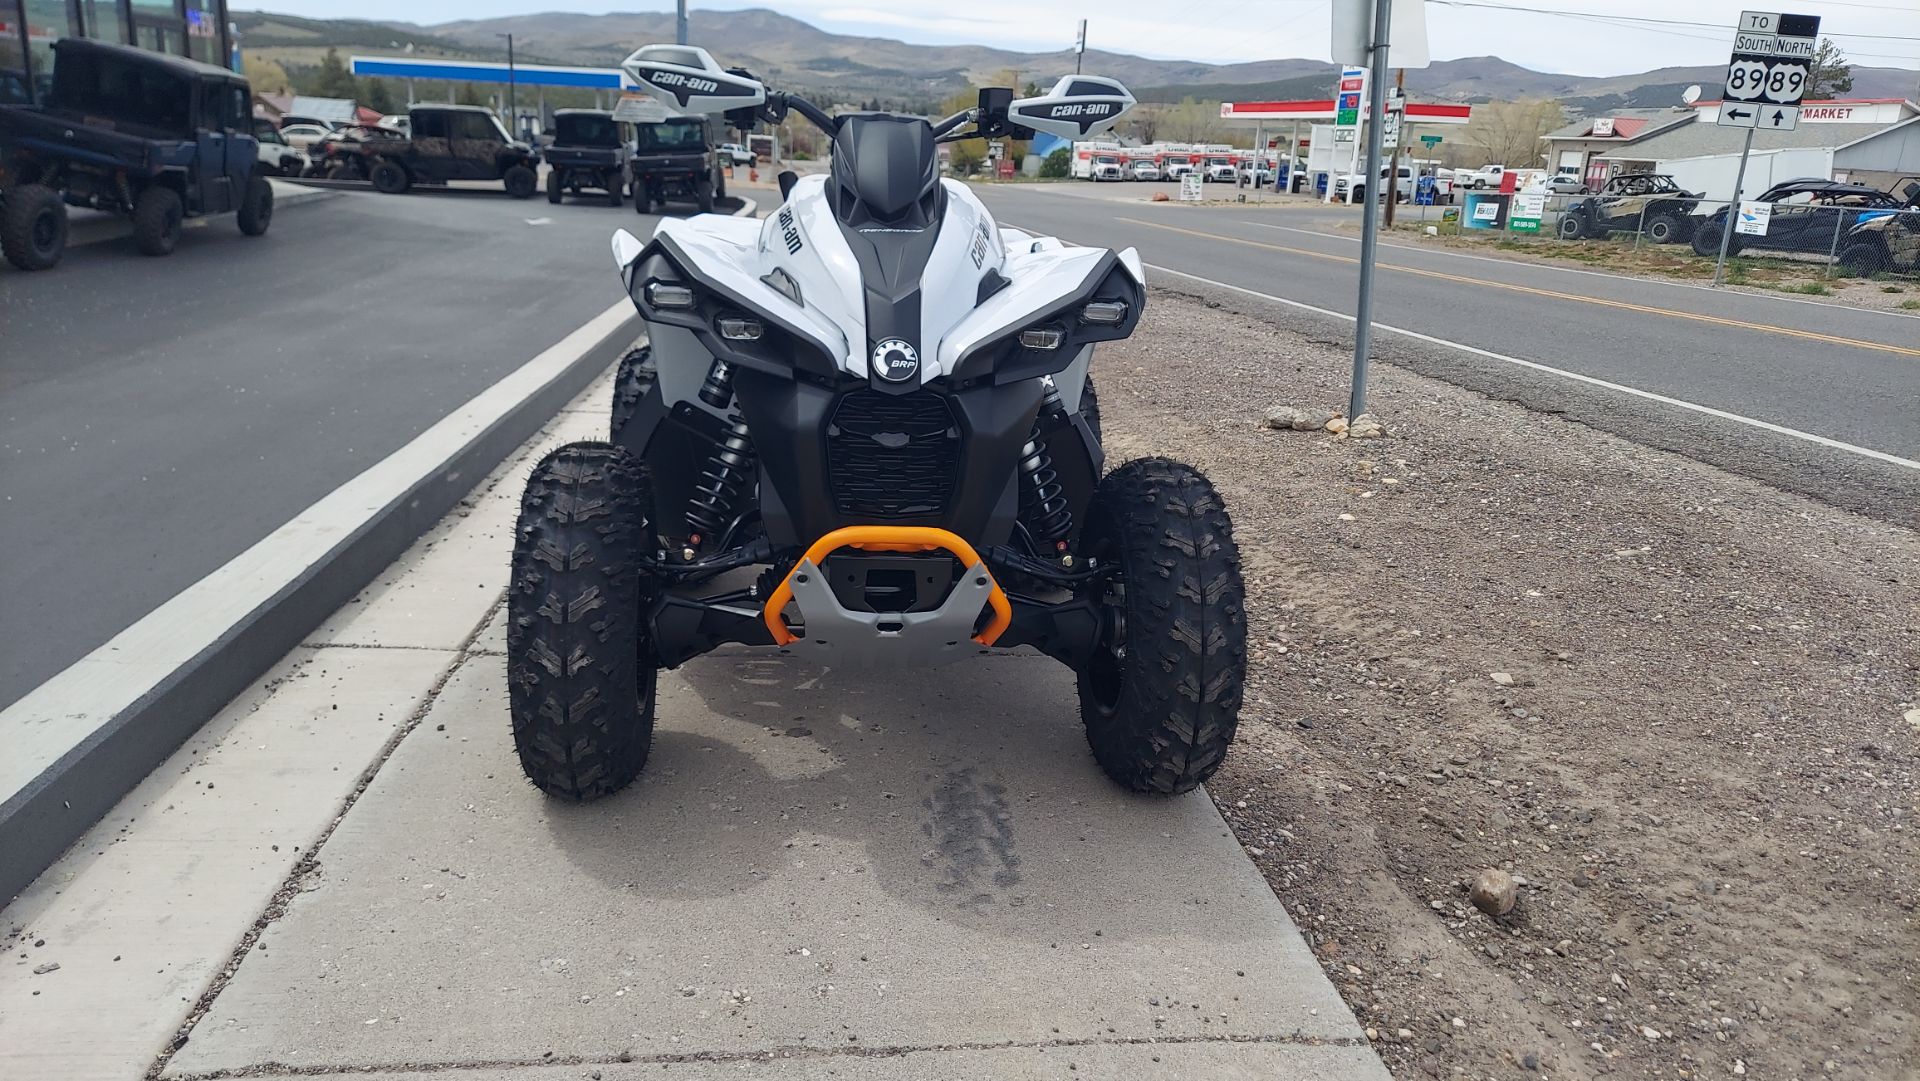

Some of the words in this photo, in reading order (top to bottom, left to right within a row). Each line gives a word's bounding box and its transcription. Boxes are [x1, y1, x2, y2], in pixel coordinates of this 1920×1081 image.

[1751, 16, 1769, 29] TO
[1736, 36, 1772, 52] SOUTH
[1775, 39, 1813, 55] NORTH
[651, 70, 718, 93] can-am
[1731, 68, 1763, 91] 89
[1770, 71, 1802, 93] 89
[1050, 103, 1111, 117] can-am
[1803, 108, 1853, 119] MARKET
[891, 359, 916, 369] BRP
